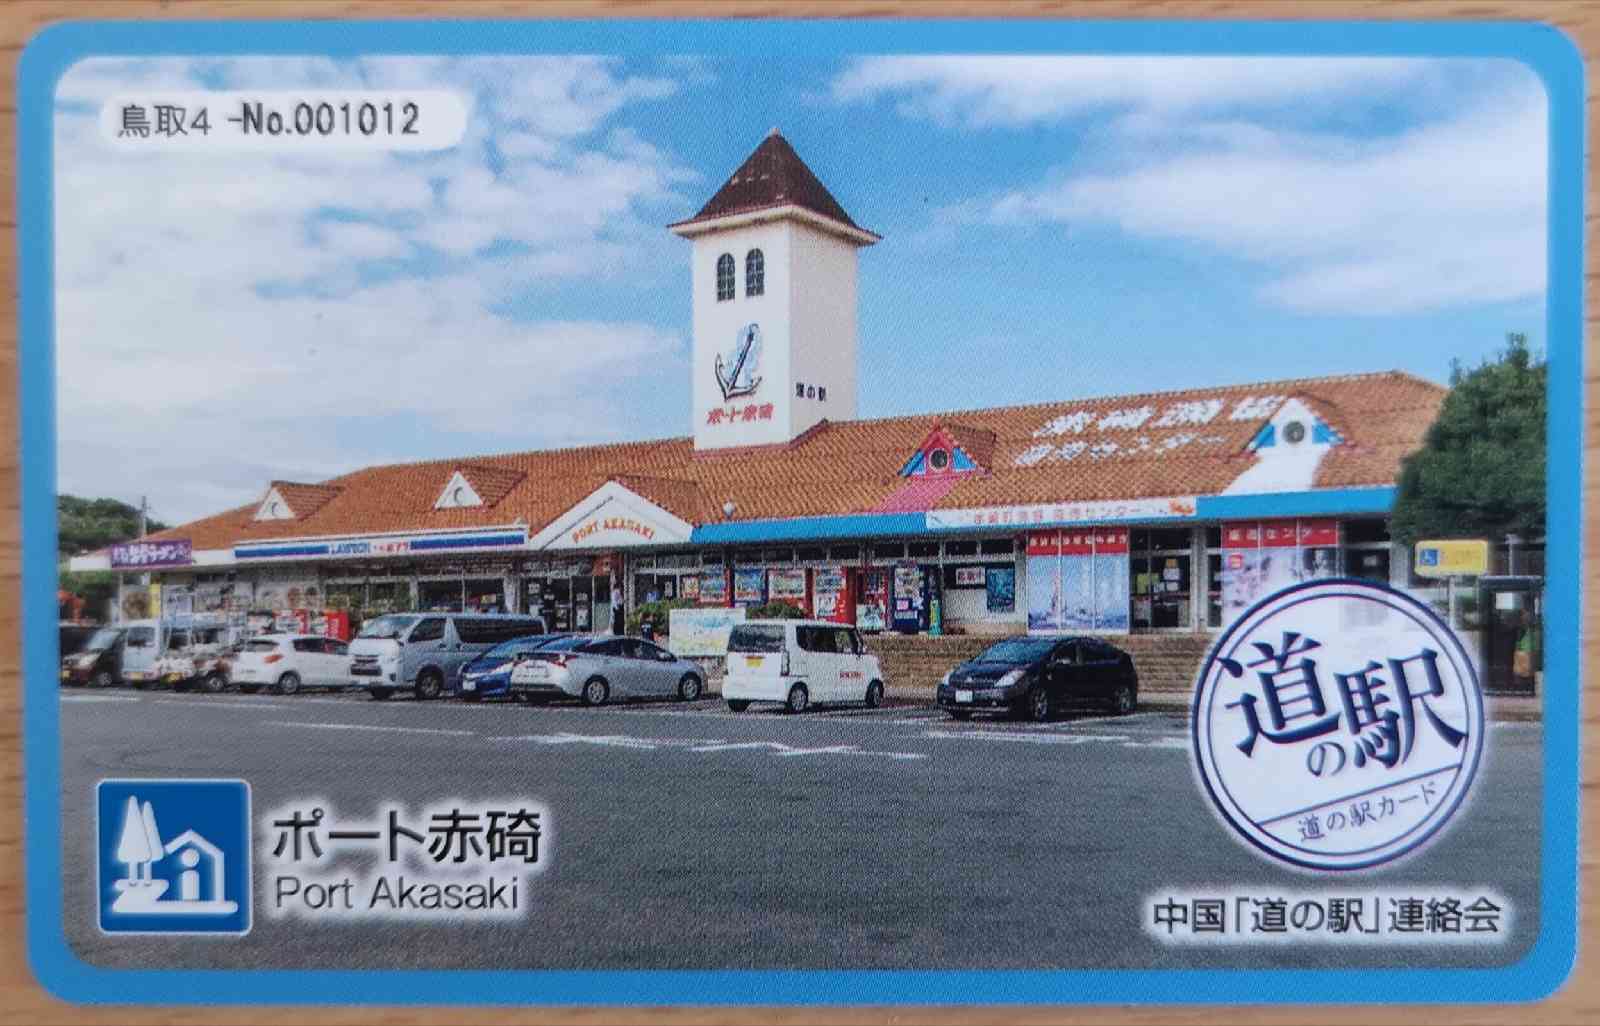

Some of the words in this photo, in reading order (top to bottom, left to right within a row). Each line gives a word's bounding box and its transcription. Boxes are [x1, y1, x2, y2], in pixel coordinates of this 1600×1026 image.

[118, 104, 212, 138] 鳥取4
[1217, 631, 1470, 777] 道の駅
[1297, 781, 1438, 842] 道の駅カード
[272, 807, 542, 864] ポート赤碕
[276, 876, 354, 909] Port
[369, 876, 519, 909] Akasaki
[1153, 897, 1501, 934] 中国「道の駅」連絡会
